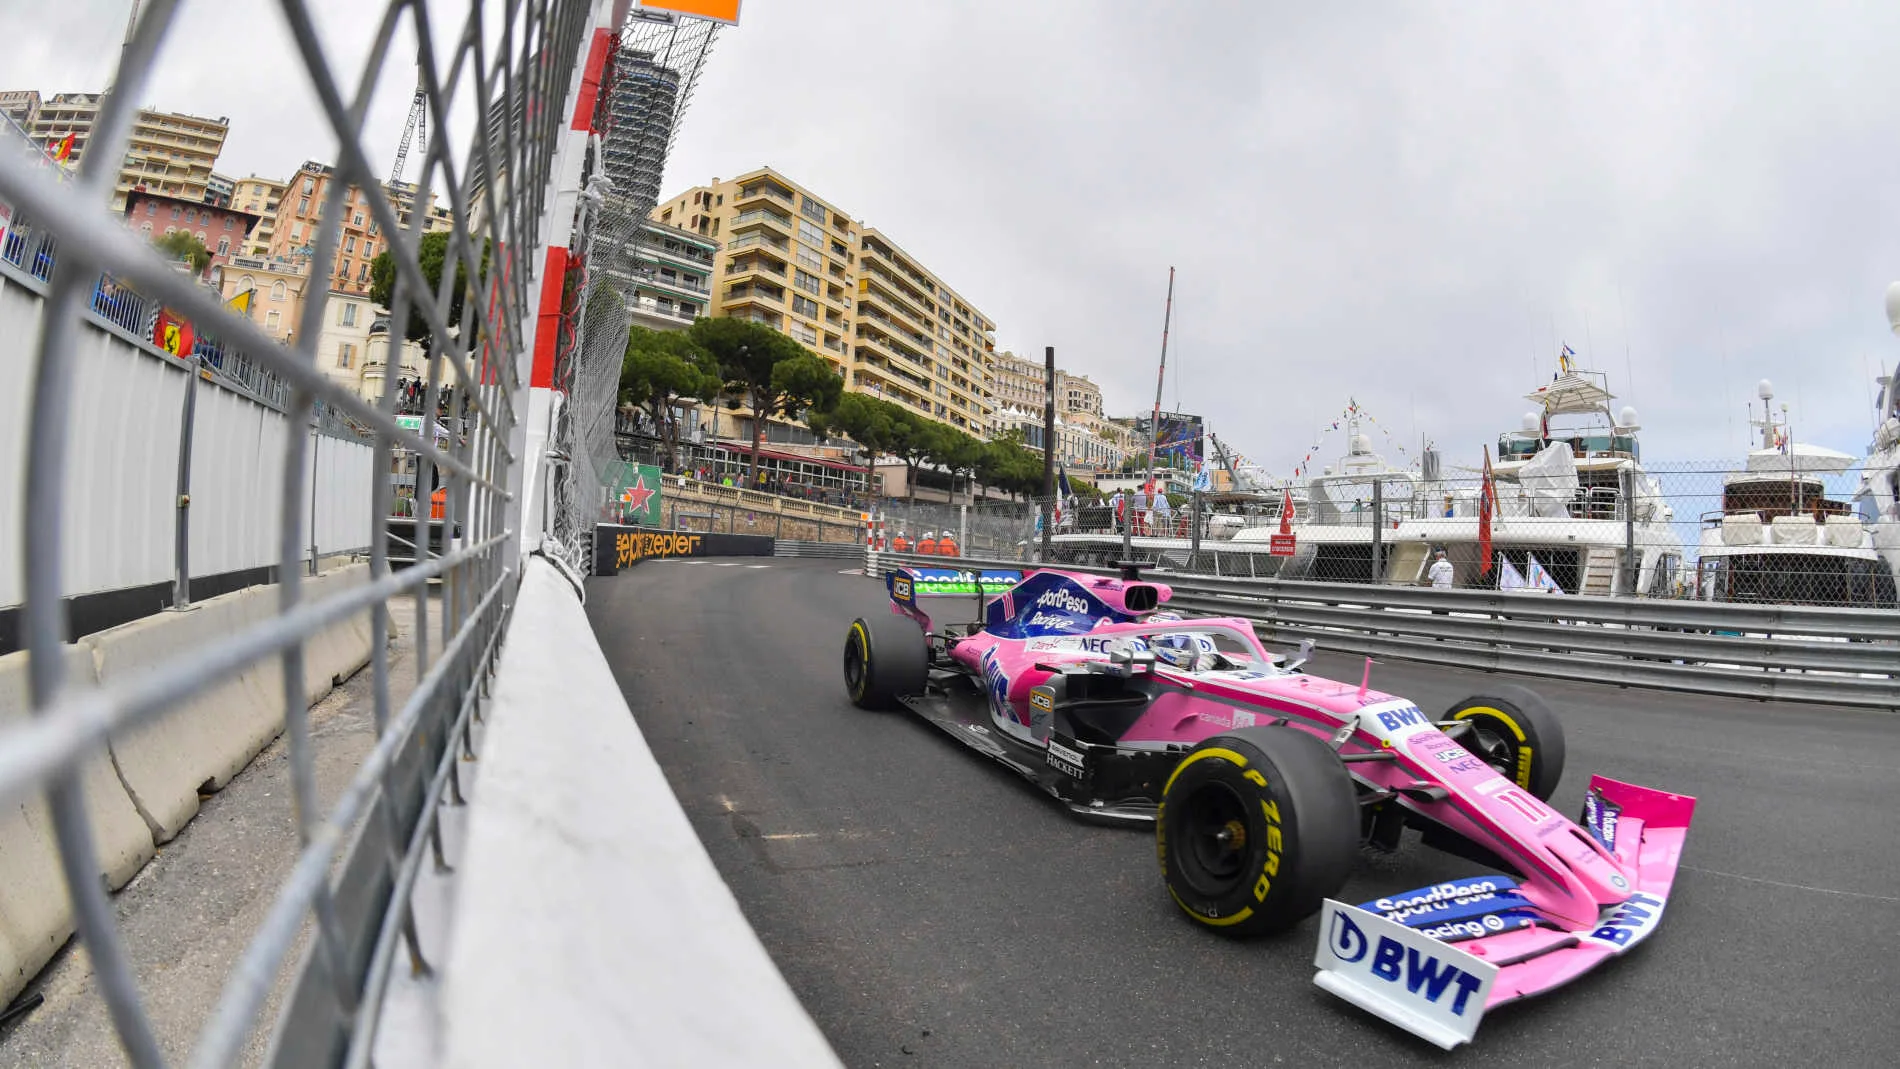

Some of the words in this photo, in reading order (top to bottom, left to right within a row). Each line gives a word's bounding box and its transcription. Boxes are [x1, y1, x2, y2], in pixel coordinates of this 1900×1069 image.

[895, 580, 909, 596] JCB
[1002, 591, 1015, 622] 11
[1079, 638, 1111, 655] NEC
[1032, 694, 1051, 708] JCB
[1376, 706, 1429, 732] BWT
[1046, 753, 1084, 779] HACKETT
[1433, 748, 1469, 763] JCB
[1450, 760, 1483, 774] NEC
[1243, 769, 1268, 787] P
[1496, 789, 1550, 824] 11
[1253, 799, 1283, 903] ZERO
[1591, 893, 1662, 946] BWT
[1371, 935, 1483, 1016] BWT
